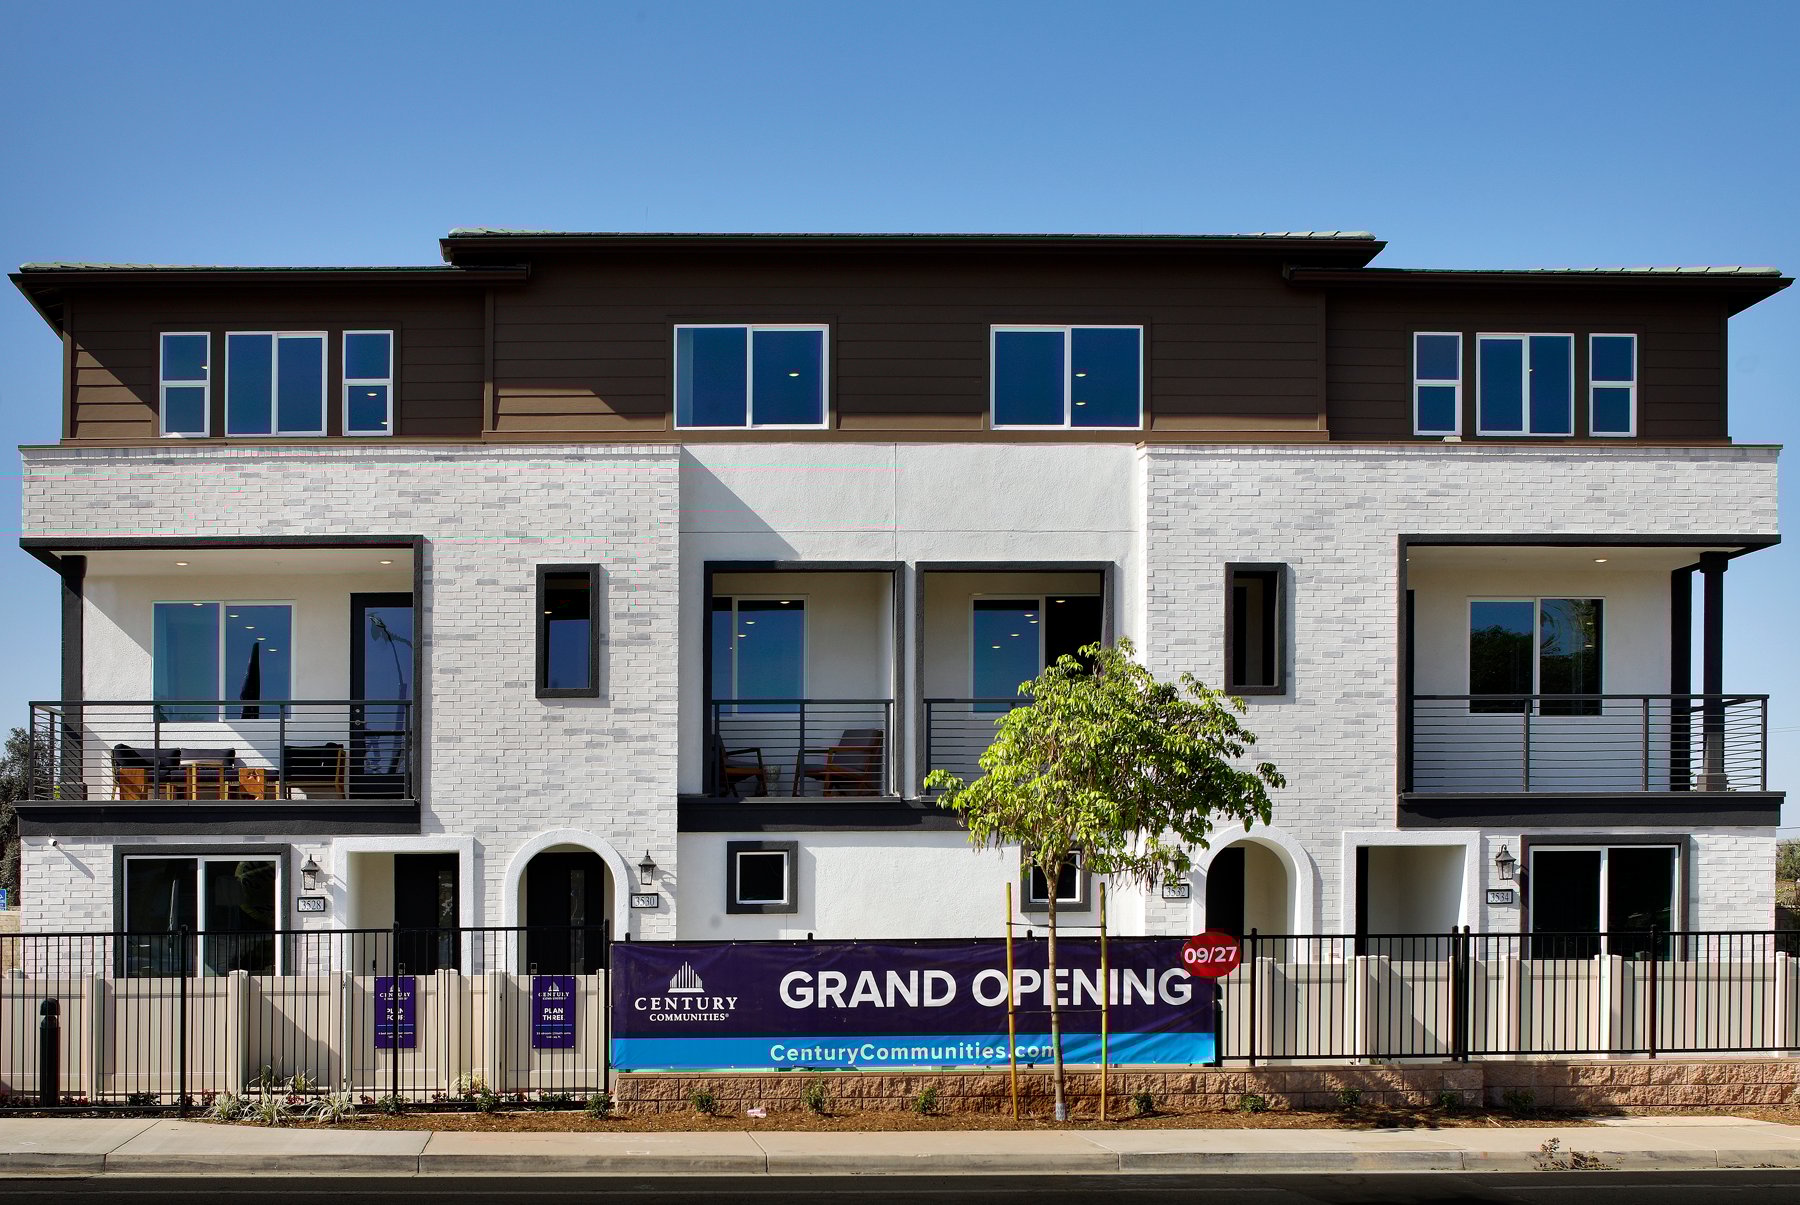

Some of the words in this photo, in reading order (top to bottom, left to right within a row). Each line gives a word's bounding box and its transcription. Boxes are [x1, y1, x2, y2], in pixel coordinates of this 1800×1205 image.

[301, 899, 322, 910] 3528
[635, 896, 655, 907] 3530
[1490, 892, 1510, 903] 3534
[1184, 946, 1237, 964] 09/27
[779, 969, 957, 1009] GRAND
[971, 968, 1192, 1007] OPENING
[634, 996, 738, 1010] CENTURY
[770, 1041, 1056, 1064] CenturyCommunities.com
